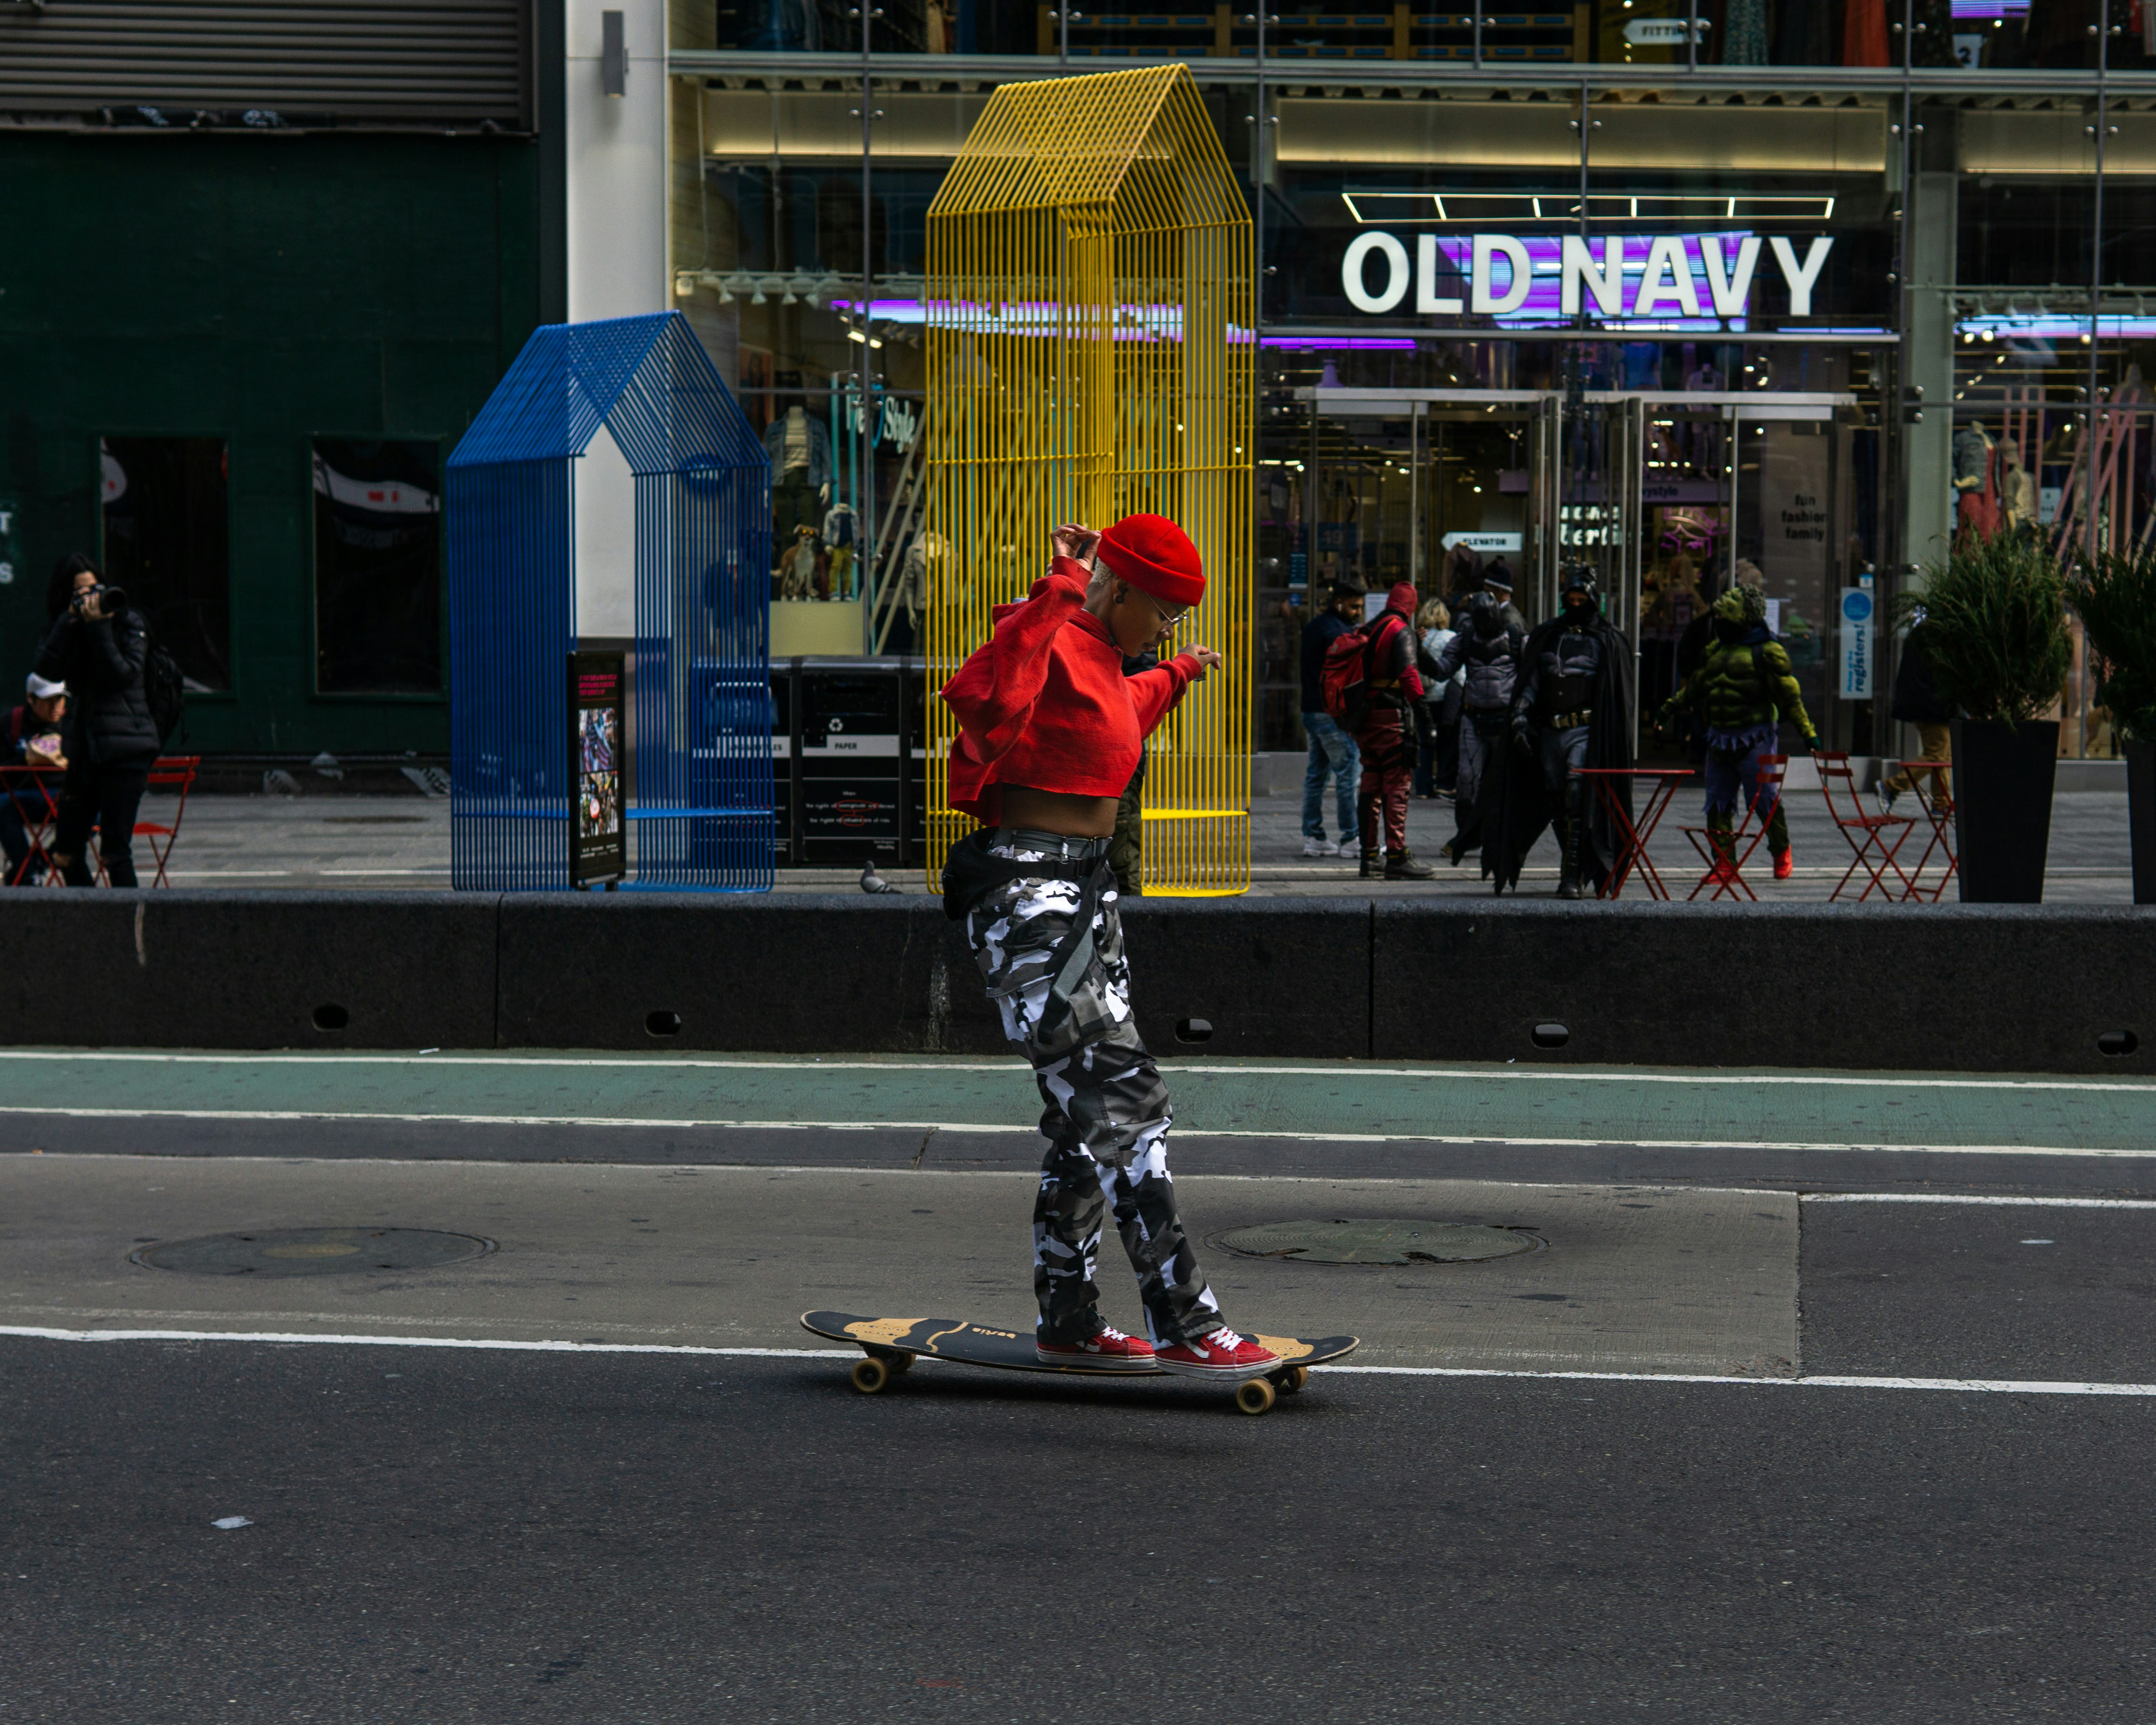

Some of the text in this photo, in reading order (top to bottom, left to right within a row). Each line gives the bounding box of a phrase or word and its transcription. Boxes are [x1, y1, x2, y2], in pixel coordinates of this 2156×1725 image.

[1341, 231, 1835, 316] OLD NAVY
[1795, 494, 1816, 506] fun
[1786, 526, 1824, 542] family
[1854, 623, 1867, 692] registers!
